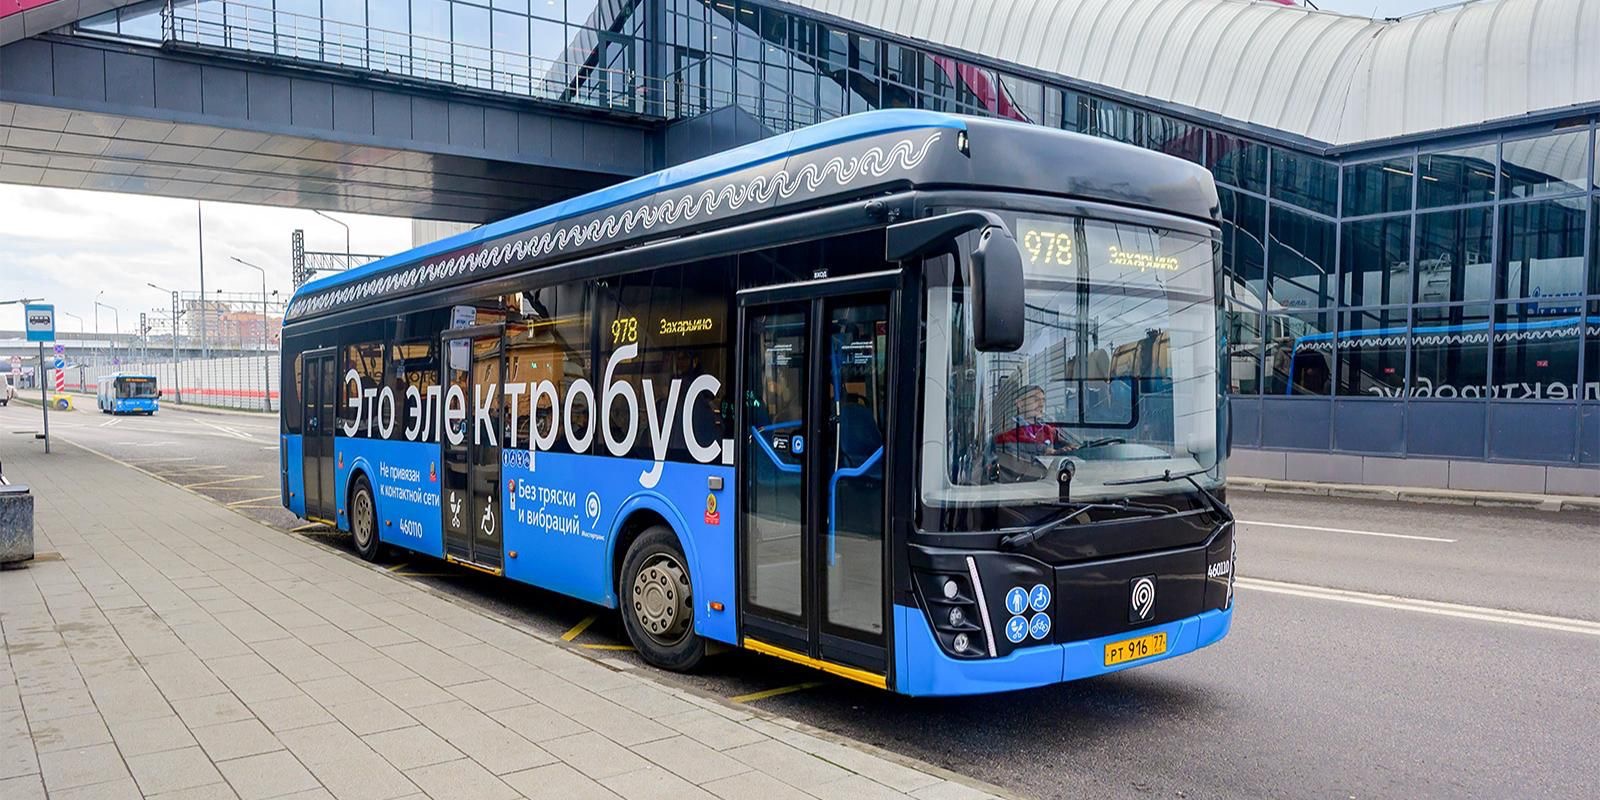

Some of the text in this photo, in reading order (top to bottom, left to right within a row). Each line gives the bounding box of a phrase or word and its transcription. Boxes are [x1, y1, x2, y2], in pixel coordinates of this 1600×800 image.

[1024, 230, 1072, 266] 978
[612, 317, 713, 344] 978 Захарьино
[343, 342, 735, 488] Это электробус.
[380, 461, 421, 483] Не привязан
[380, 484, 440, 507] к контактной сети
[518, 478, 576, 508] Без тряски
[400, 518, 423, 538] 460110
[518, 507, 580, 535] и вибраций
[1208, 560, 1229, 578] 460110
[1128, 639, 1148, 658] 916
[1153, 634, 1163, 648] 77
